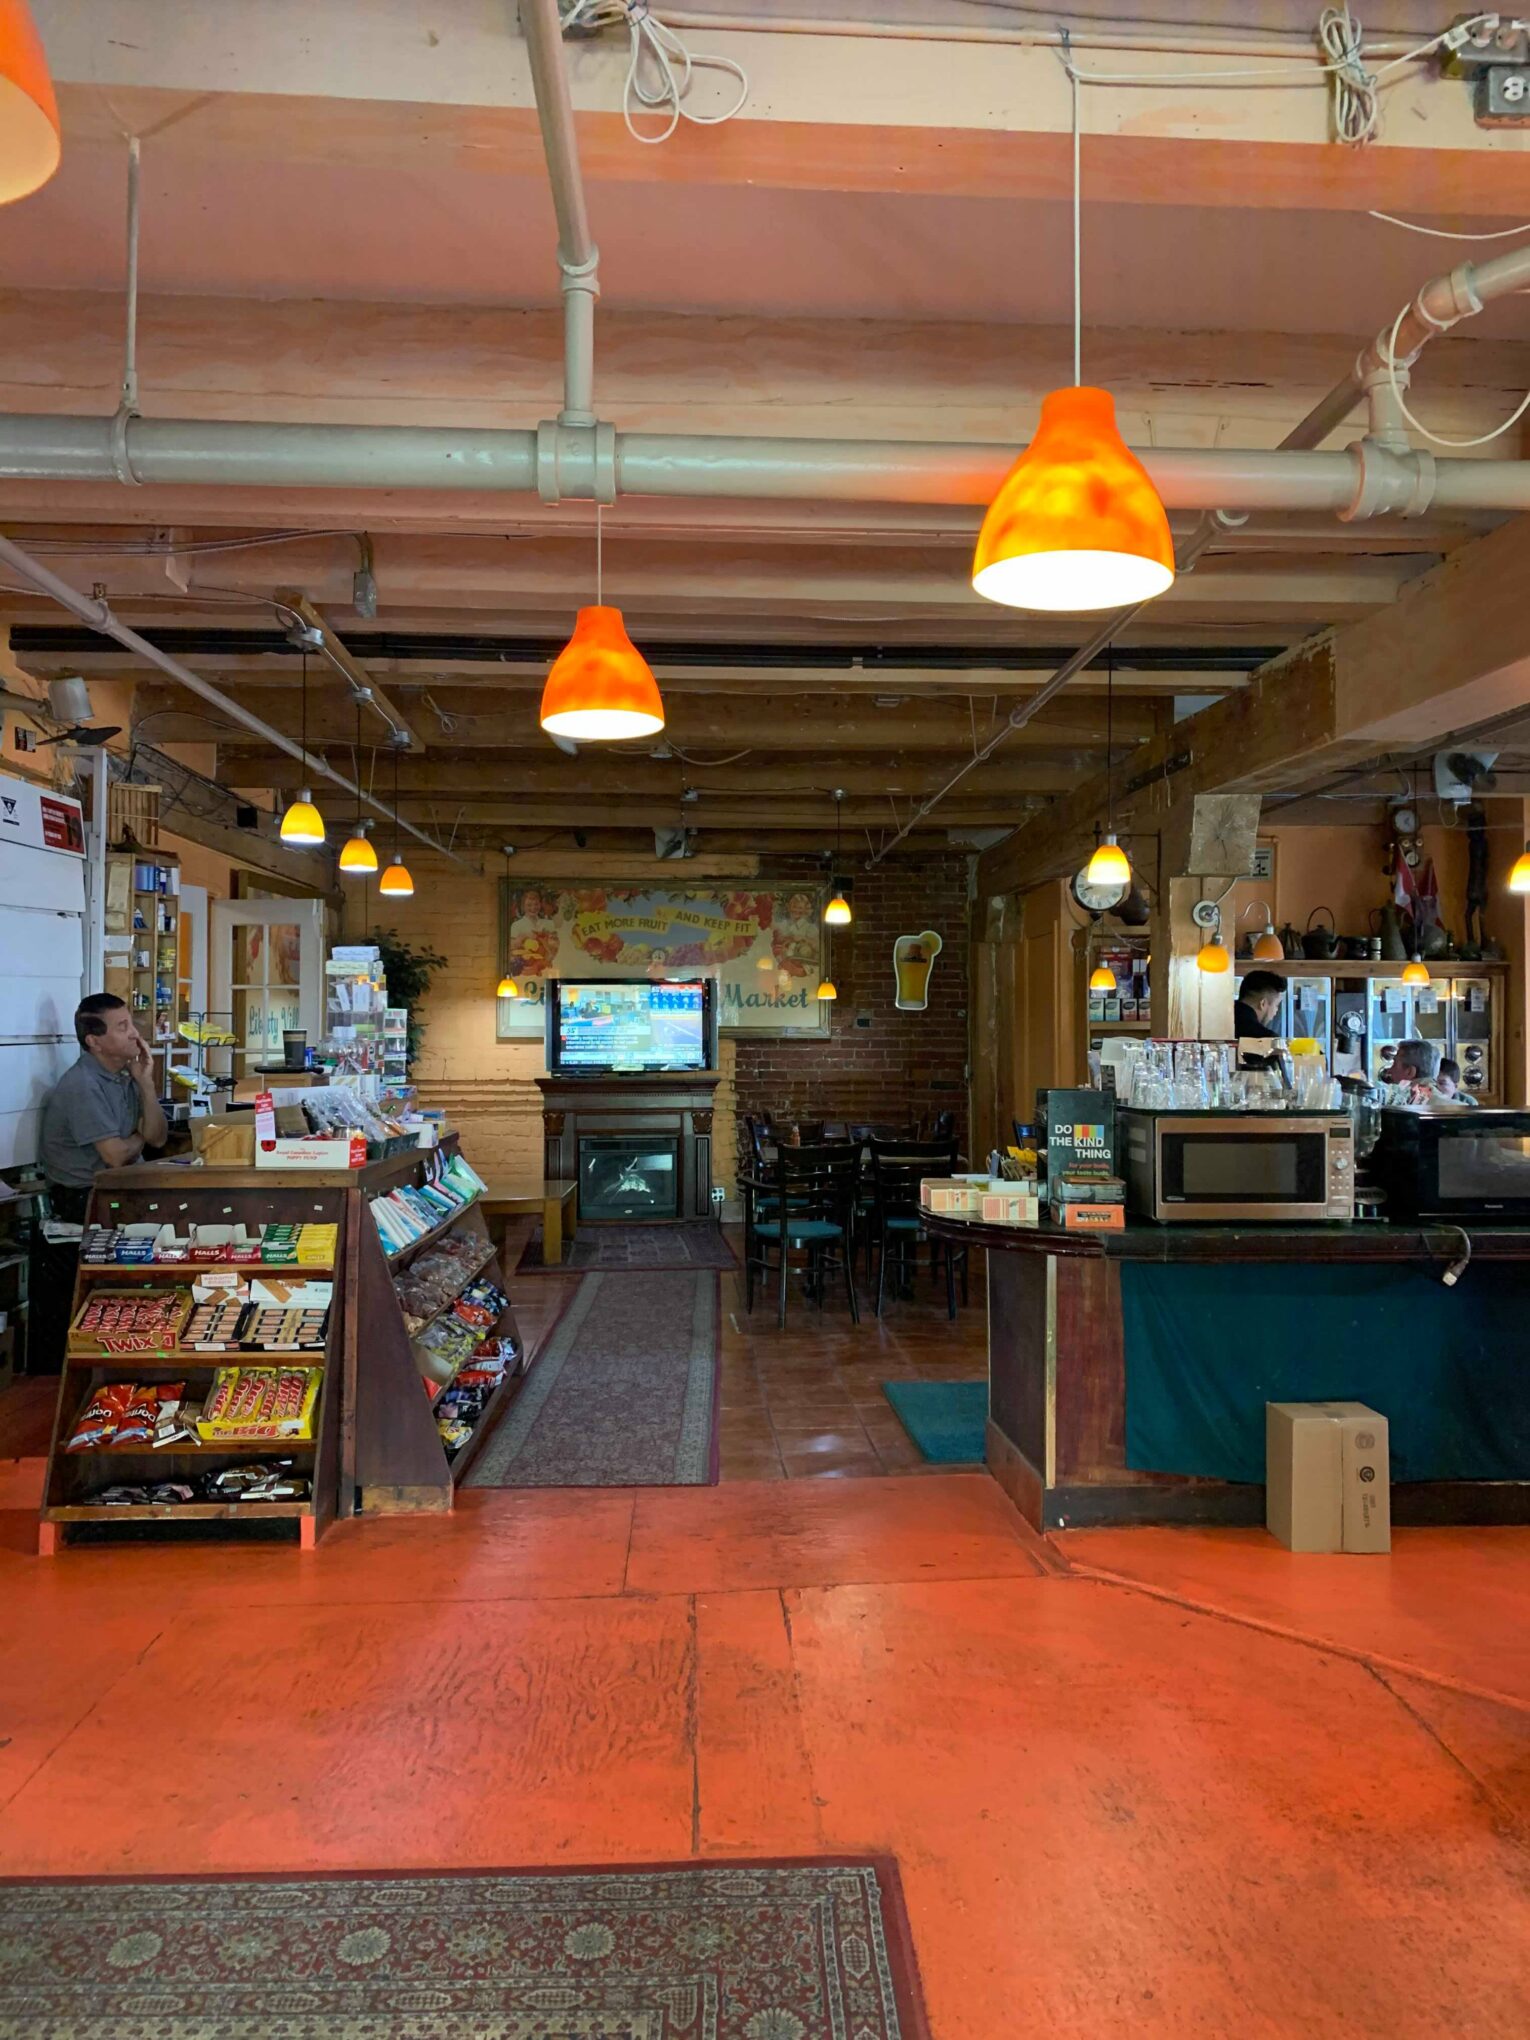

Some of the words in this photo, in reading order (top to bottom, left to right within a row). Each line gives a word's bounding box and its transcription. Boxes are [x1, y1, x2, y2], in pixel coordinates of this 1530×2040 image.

[581, 922, 601, 937] EAT
[604, 917, 634, 931] MORE
[638, 917, 669, 931] FRUIT
[675, 911, 700, 925] AND
[703, 917, 731, 931] KEEP
[735, 922, 752, 933] FIT
[721, 983, 809, 1010] Market
[248, 1005, 279, 1045] Libty
[1054, 1124, 1073, 1135] DO
[1049, 1136, 1073, 1147] THE
[1073, 1137, 1105, 1148] KIND
[1074, 1148, 1112, 1159] THING
[194, 1249, 220, 1257] HALLS
